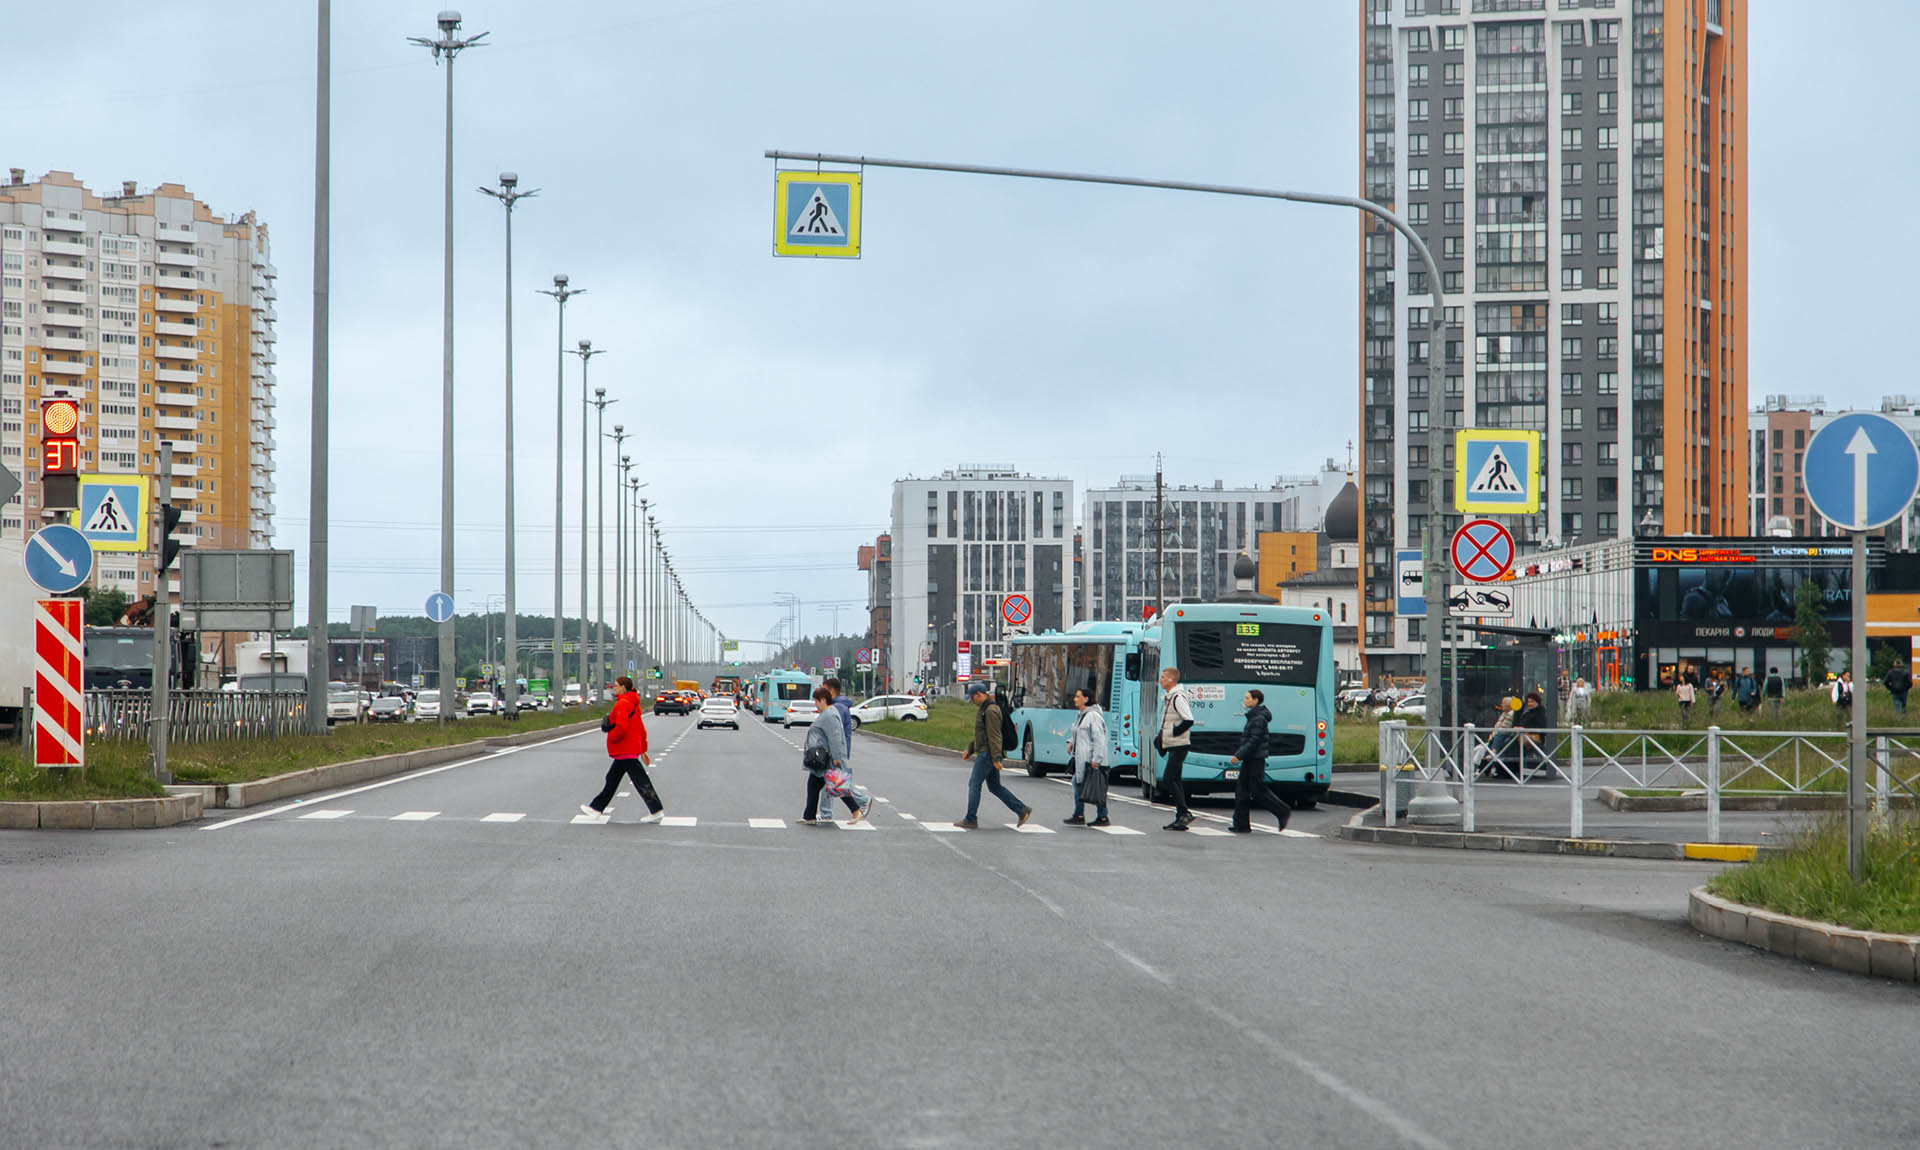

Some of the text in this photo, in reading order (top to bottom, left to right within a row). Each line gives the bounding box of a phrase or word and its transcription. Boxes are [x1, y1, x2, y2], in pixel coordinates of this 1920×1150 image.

[46, 440, 77, 470] 37
[1652, 548, 1697, 562] DNS
[1695, 627, 1730, 637] ПЕКАРНЯ
